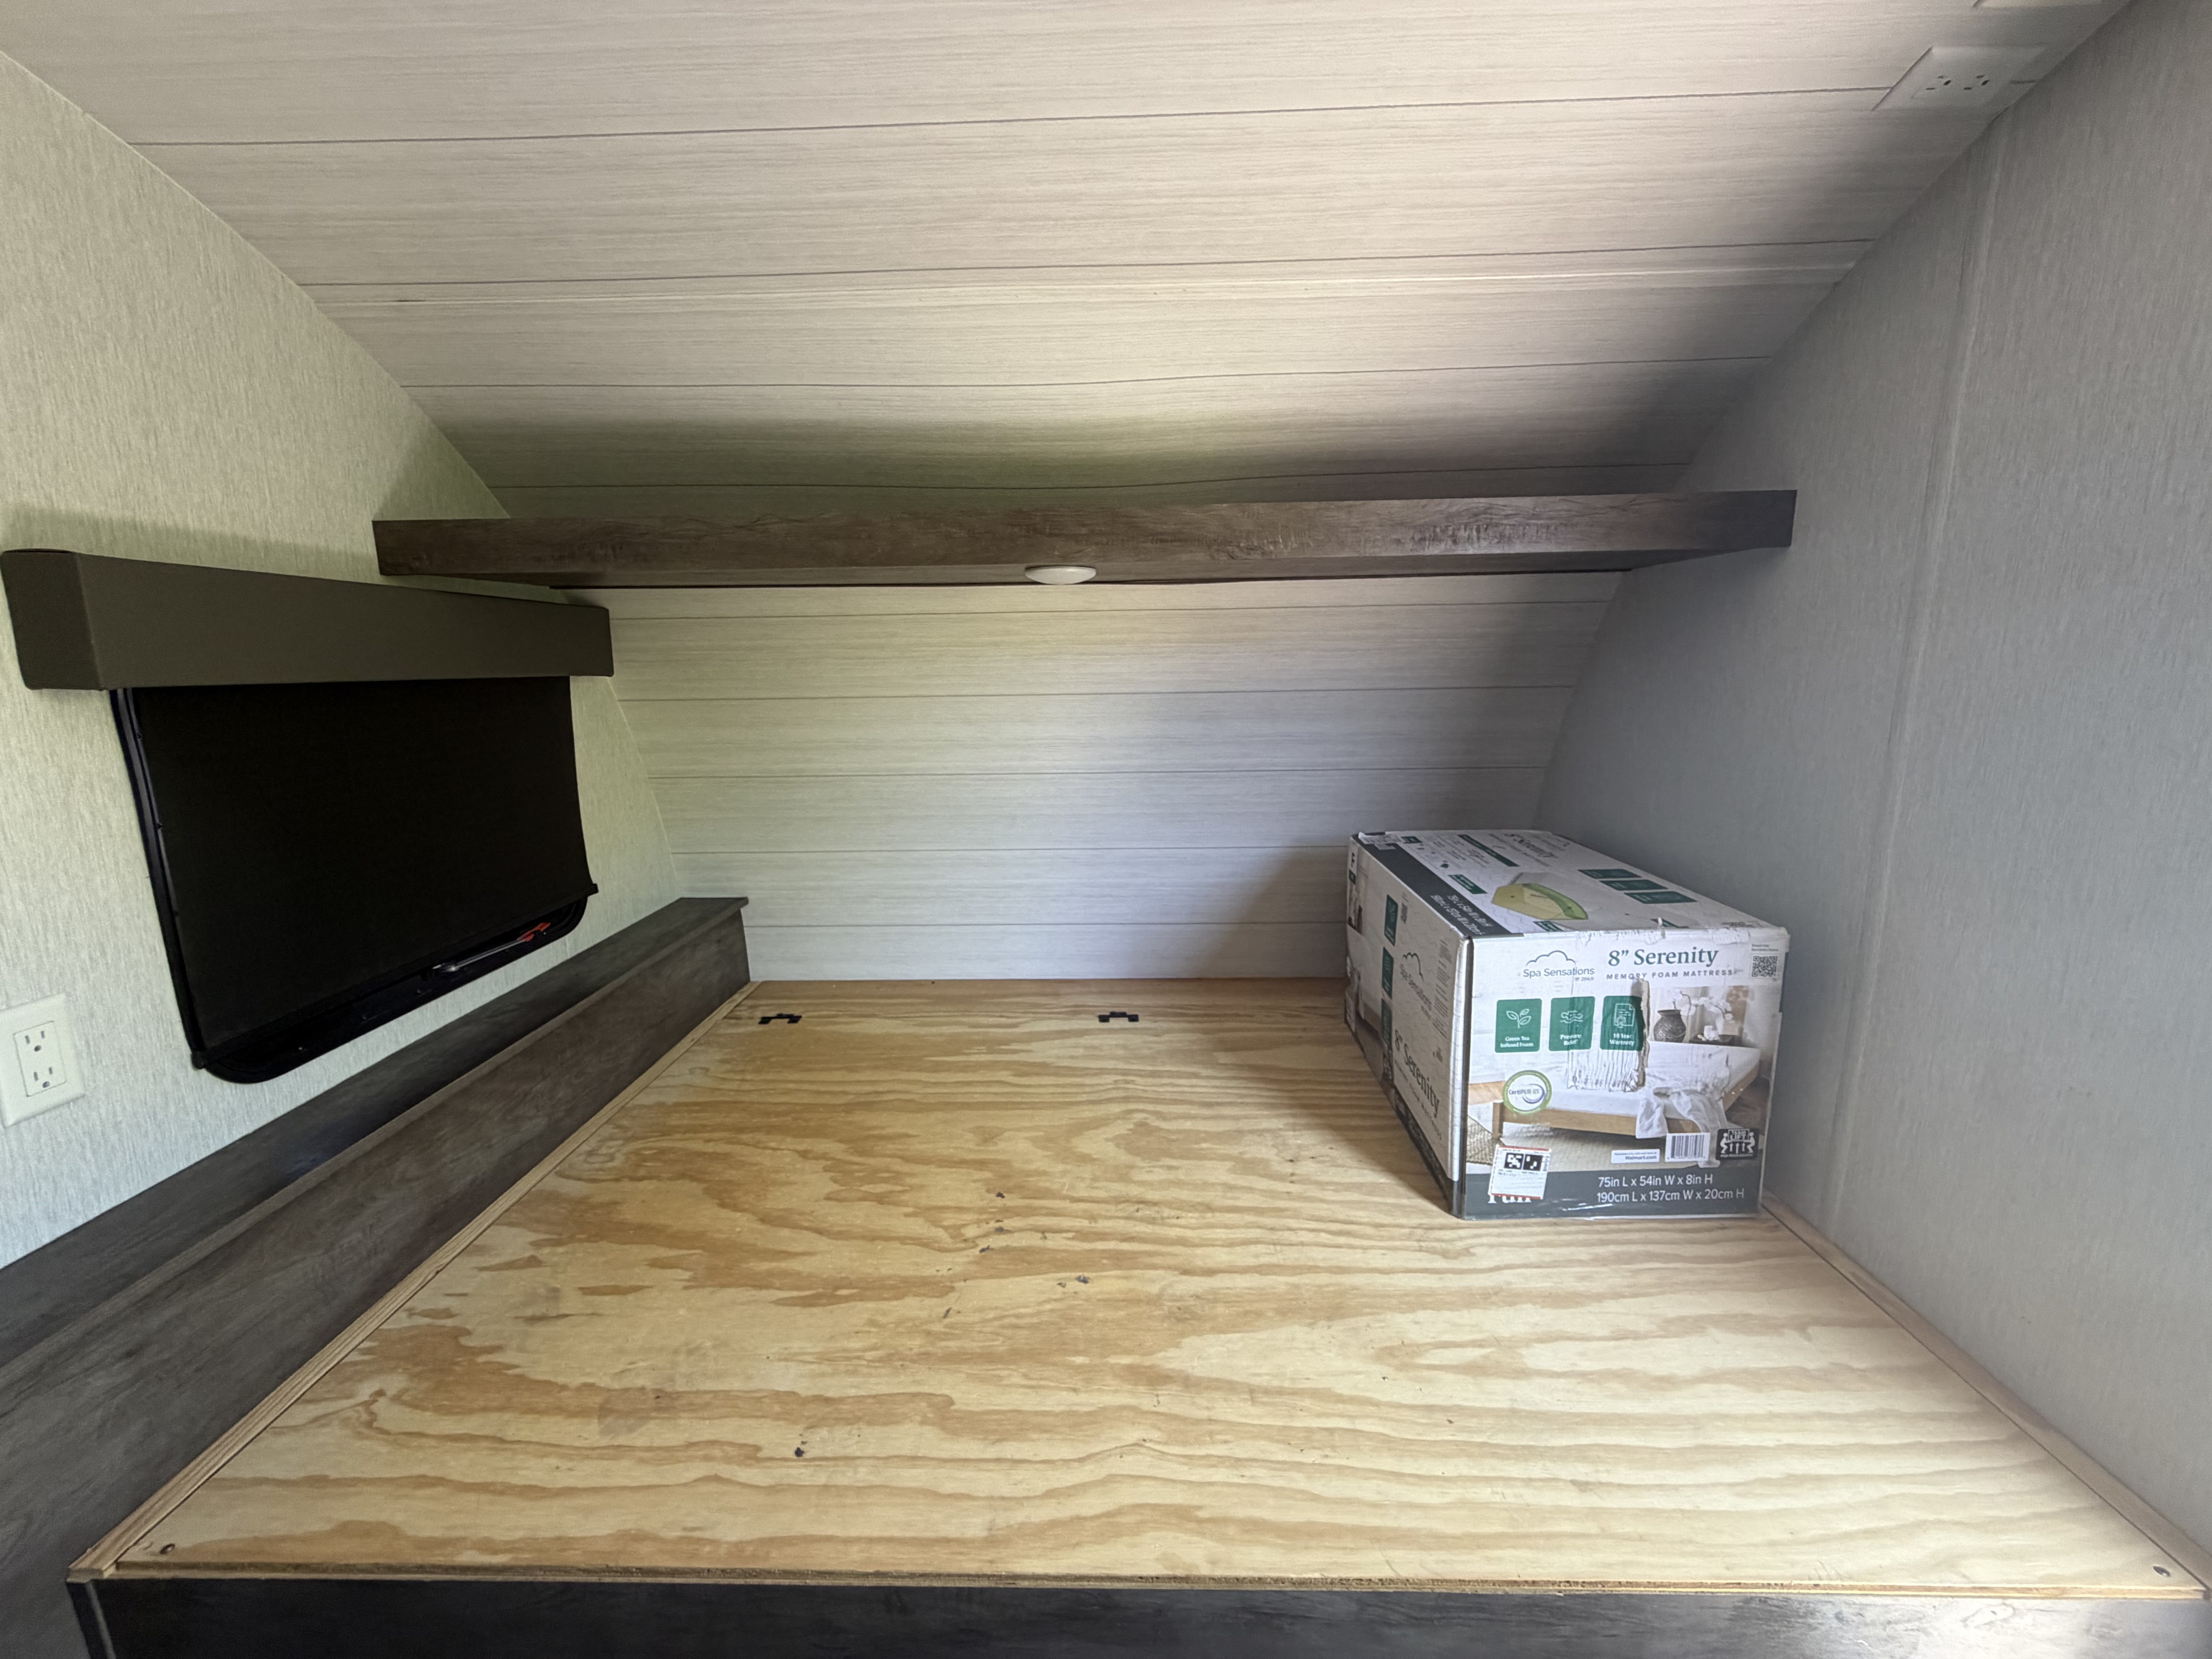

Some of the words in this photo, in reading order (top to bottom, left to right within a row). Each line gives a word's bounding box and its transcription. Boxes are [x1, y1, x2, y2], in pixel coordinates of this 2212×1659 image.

[1634, 946, 1719, 968] Serenity
[1523, 969, 1541, 979] Spa
[1543, 967, 1595, 976] Sensations
[1404, 1043, 1440, 1119] Serenity
[1598, 1177, 1619, 1187] 75in
[1622, 1176, 1628, 1187] L
[1640, 1175, 1661, 1186] 54in
[1664, 1175, 1676, 1185] W
[1686, 1174, 1702, 1185] 8in
[1705, 1173, 1713, 1184] H
[1597, 1192, 1629, 1202] 190cm
[1632, 1191, 1638, 1202] L
[1649, 1190, 1679, 1201] 137cm
[1683, 1190, 1693, 1199] W
[1704, 1188, 1733, 1199] 20cm
[1736, 1188, 1744, 1198] H
